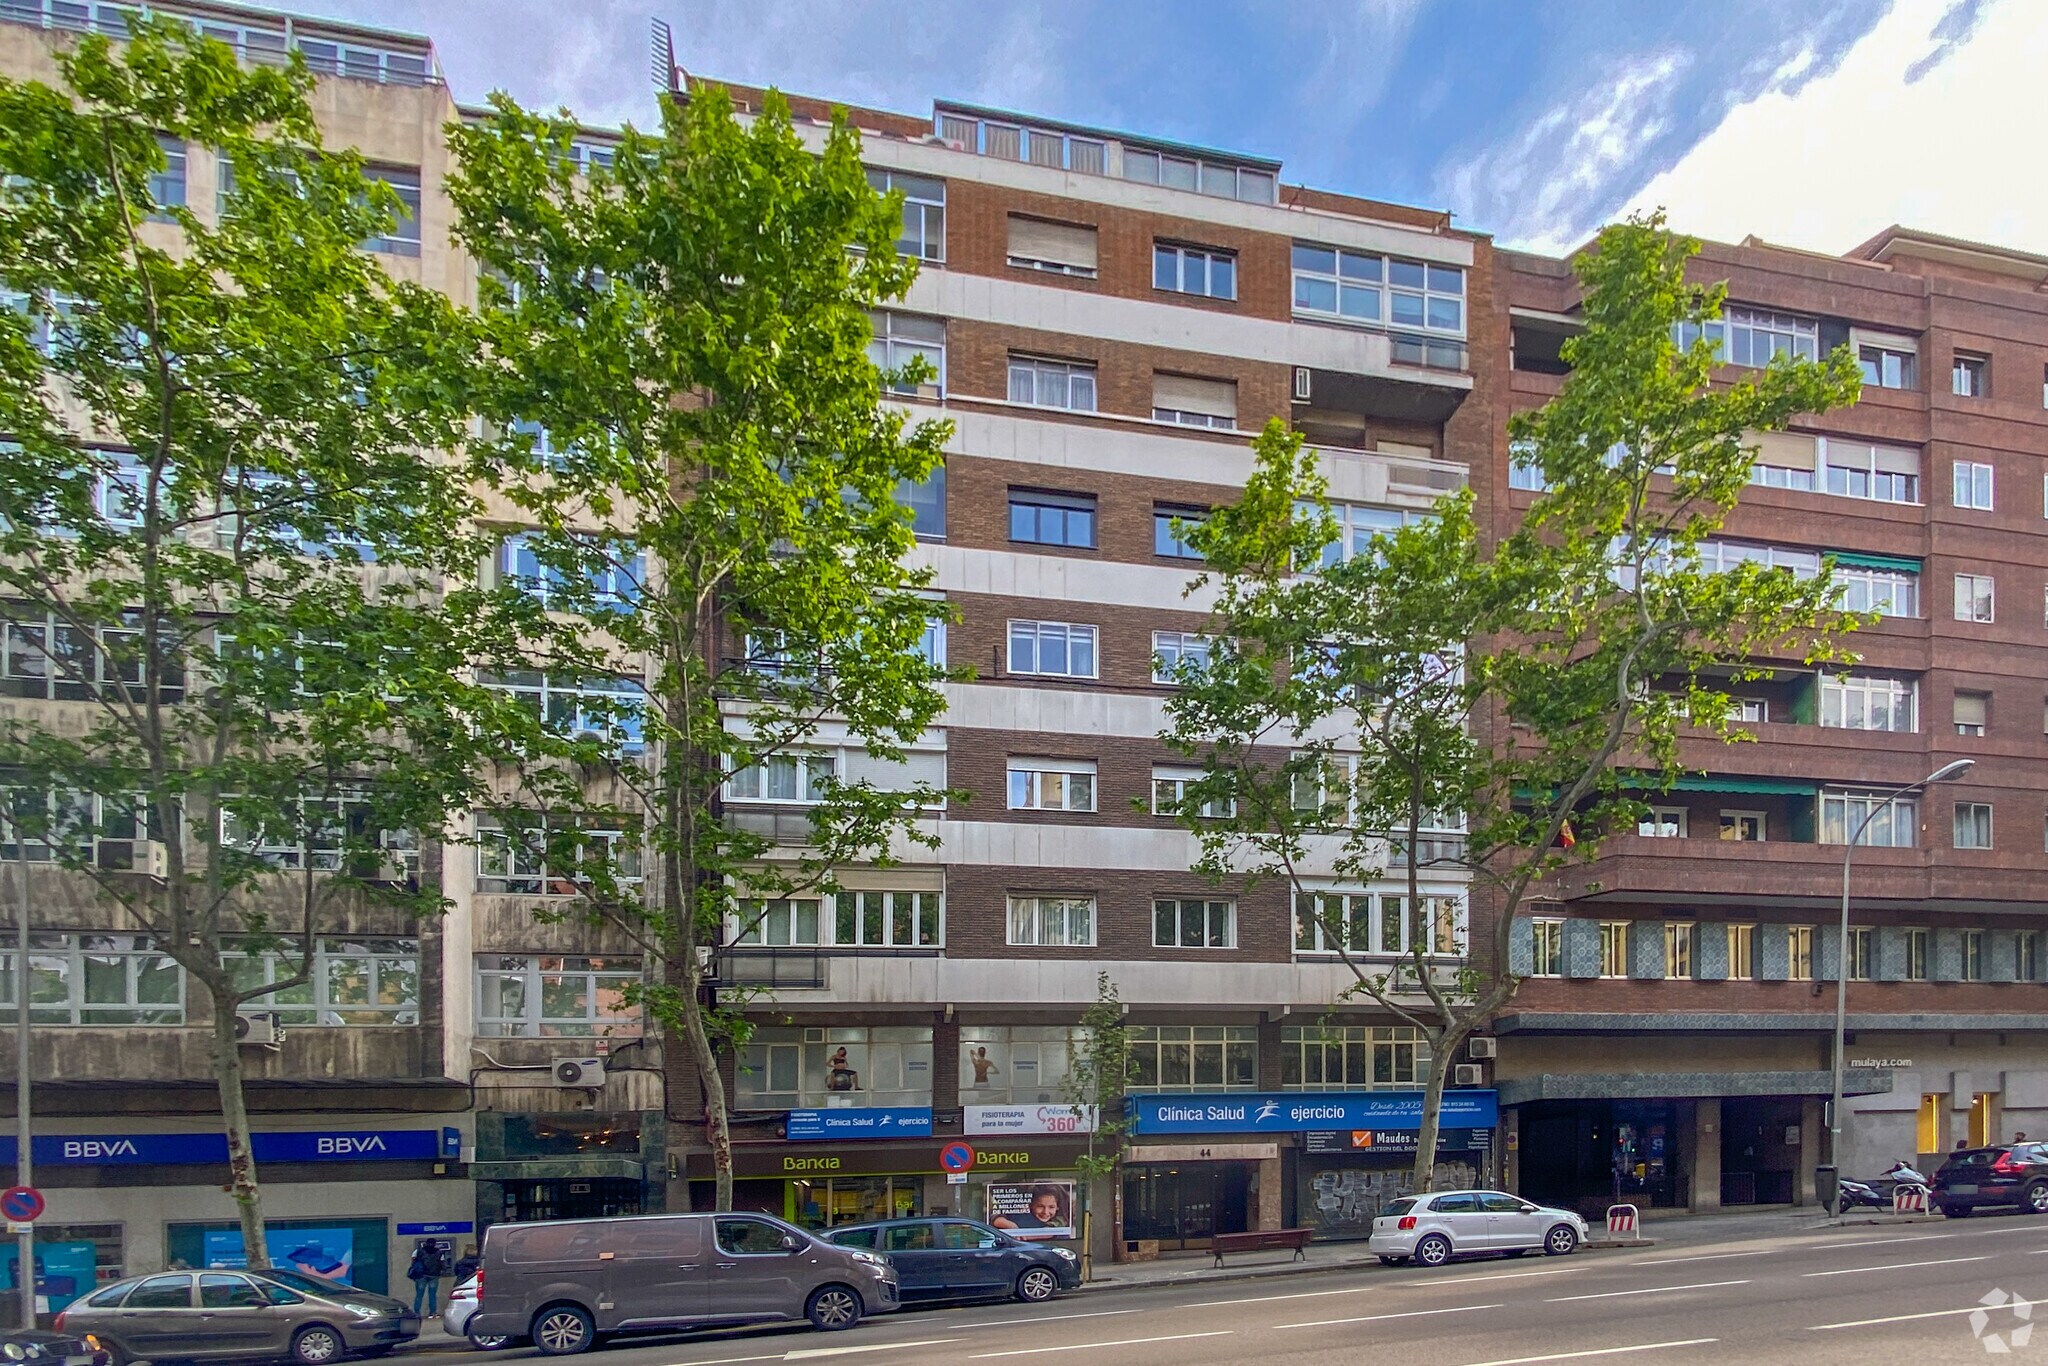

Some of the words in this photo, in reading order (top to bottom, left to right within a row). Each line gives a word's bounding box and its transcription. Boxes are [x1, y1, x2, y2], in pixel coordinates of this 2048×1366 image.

[1851, 1057, 1912, 1069] mulaya.com
[981, 1111, 1025, 1119] FISIOTERAPIA
[1158, 1106, 1203, 1121] Clínica
[1207, 1106, 1244, 1120] Salud
[1290, 1104, 1345, 1122] ejercicio
[826, 1117, 851, 1126] Clínica
[852, 1117, 874, 1126] Salud
[898, 1116, 929, 1127] ejercicio
[1004, 1120, 1024, 1129] mujer
[1376, 1132, 1410, 1144] Maudes
[64, 1139, 138, 1158] BBVA
[318, 1135, 387, 1154] BBVA
[976, 1151, 1029, 1164] Bankia
[1200, 1148, 1211, 1157] 44
[783, 1157, 840, 1170] Bankia
